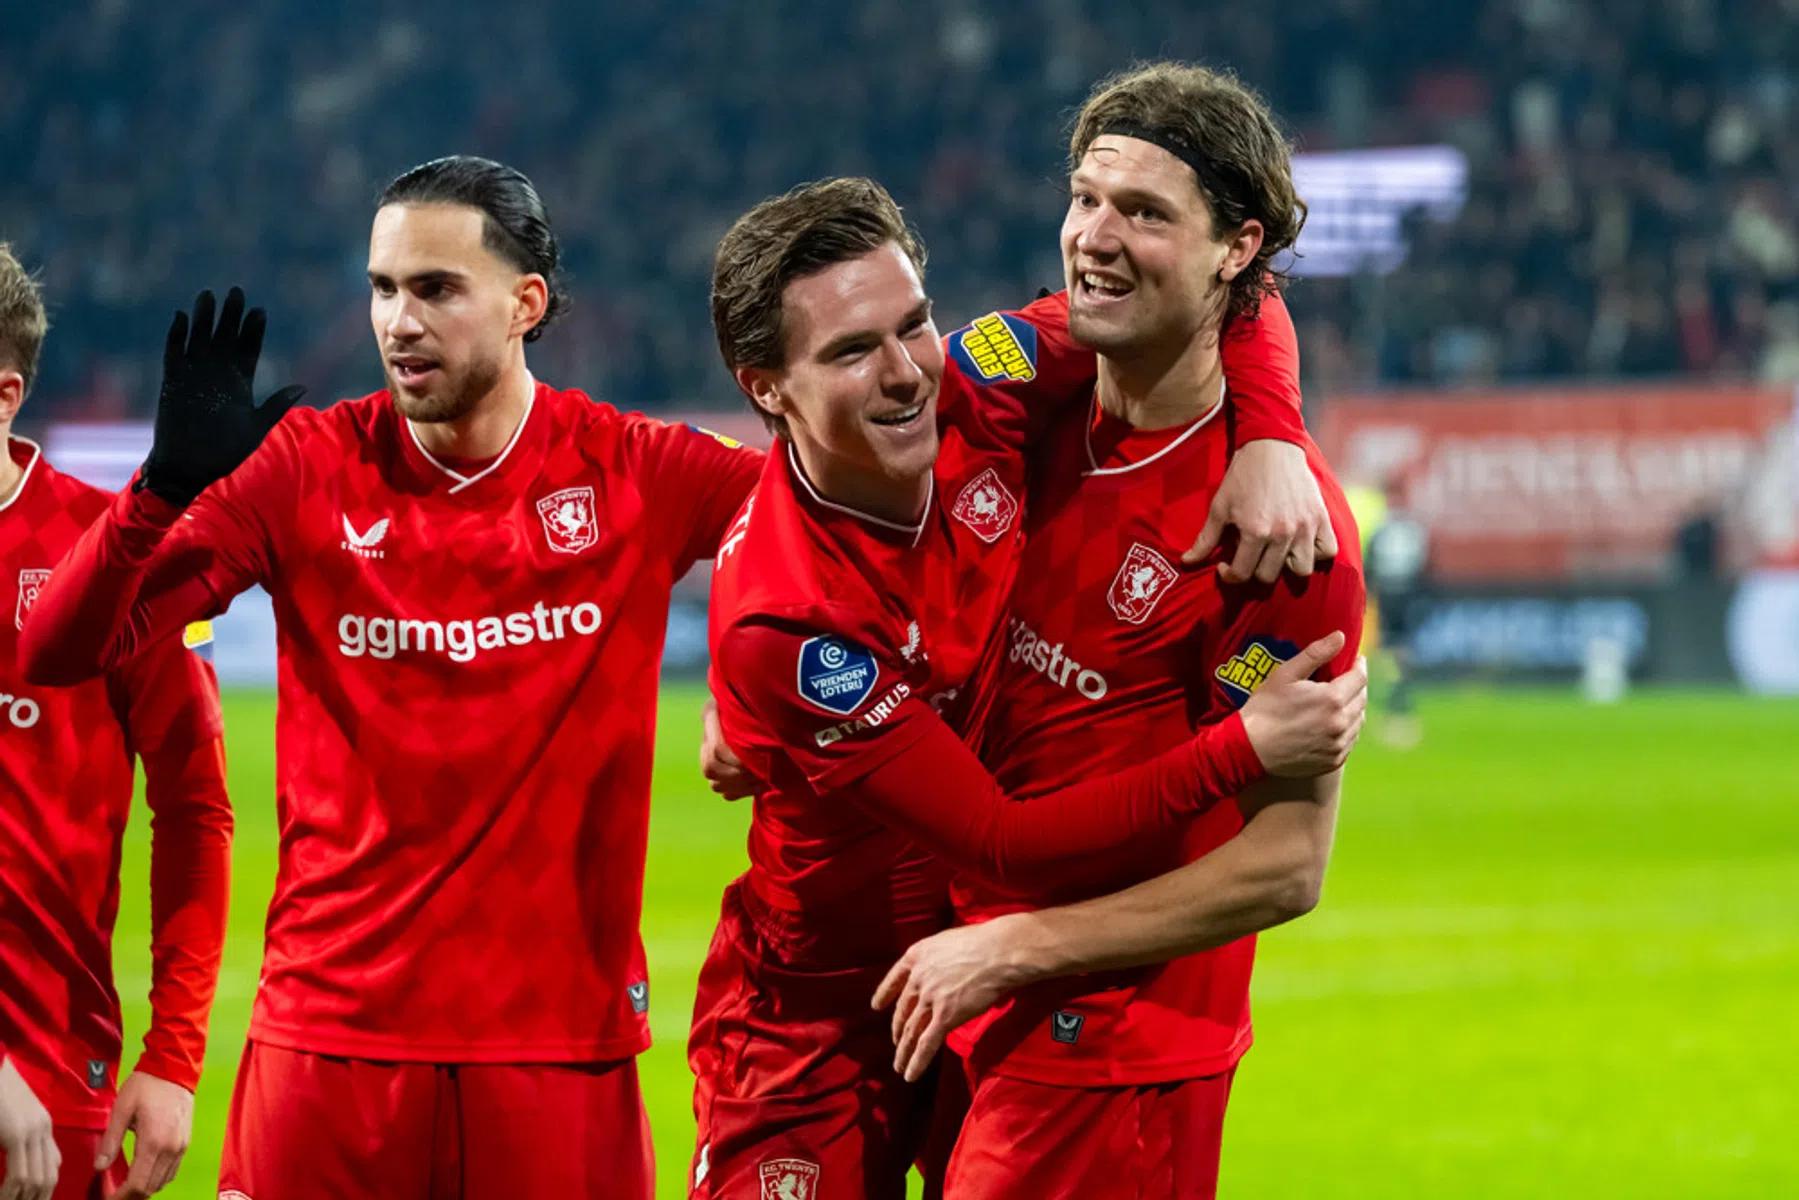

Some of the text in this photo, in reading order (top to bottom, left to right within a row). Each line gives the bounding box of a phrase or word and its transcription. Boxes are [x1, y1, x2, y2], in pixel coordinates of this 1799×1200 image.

[964, 330, 1005, 377] EURO
[338, 601, 602, 662] ggmgastro
[811, 667, 868, 690] VRIENDEN
[1244, 646, 1280, 675] EU
[839, 683, 911, 735] TAURUS
